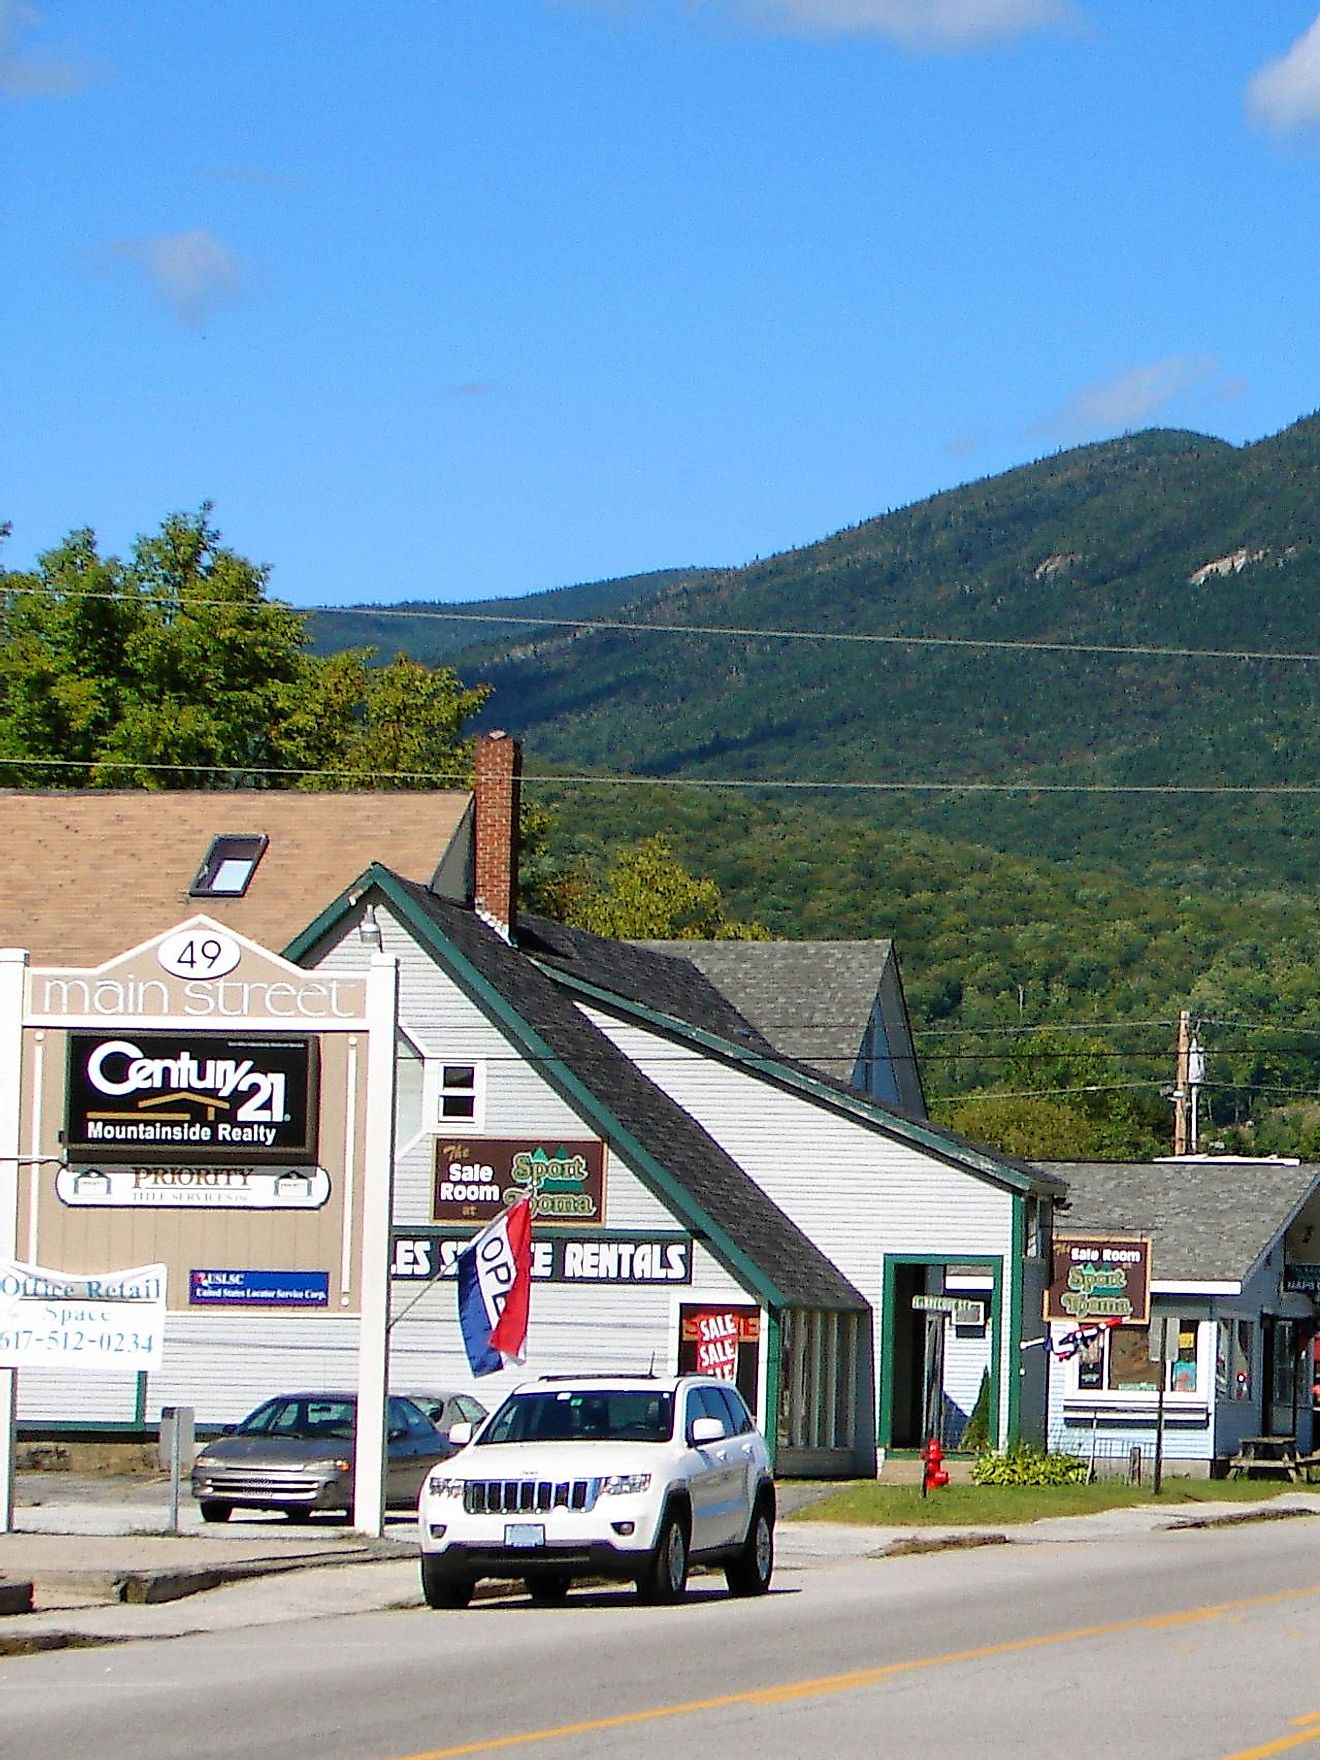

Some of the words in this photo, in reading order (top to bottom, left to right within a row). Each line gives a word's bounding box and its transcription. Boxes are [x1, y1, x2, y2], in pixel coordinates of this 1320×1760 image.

[177, 940, 222, 969] 49
[44, 974, 170, 1014] main
[184, 977, 357, 1018] street
[87, 1040, 255, 1097] Century
[237, 1073, 286, 1122] 21
[87, 1121, 211, 1142] Mountainside
[218, 1122, 277, 1146] Realty
[443, 1144, 471, 1160] The
[132, 1167, 254, 1189] PRIORITY
[449, 1163, 494, 1182] Sale
[512, 1152, 589, 1188] Sport
[440, 1183, 500, 1201] Room
[390, 1241, 432, 1275] ES
[565, 1243, 686, 1280] RENTALS
[1071, 1247, 1100, 1261] Sale
[1102, 1248, 1141, 1263] Room
[0, 1275, 75, 1297] Office
[86, 1279, 160, 1299] Retail
[1067, 1265, 1128, 1294] Sport
[45, 1306, 111, 1325] Space
[700, 1314, 738, 1341] SALE
[700, 1339, 736, 1367] SALE
